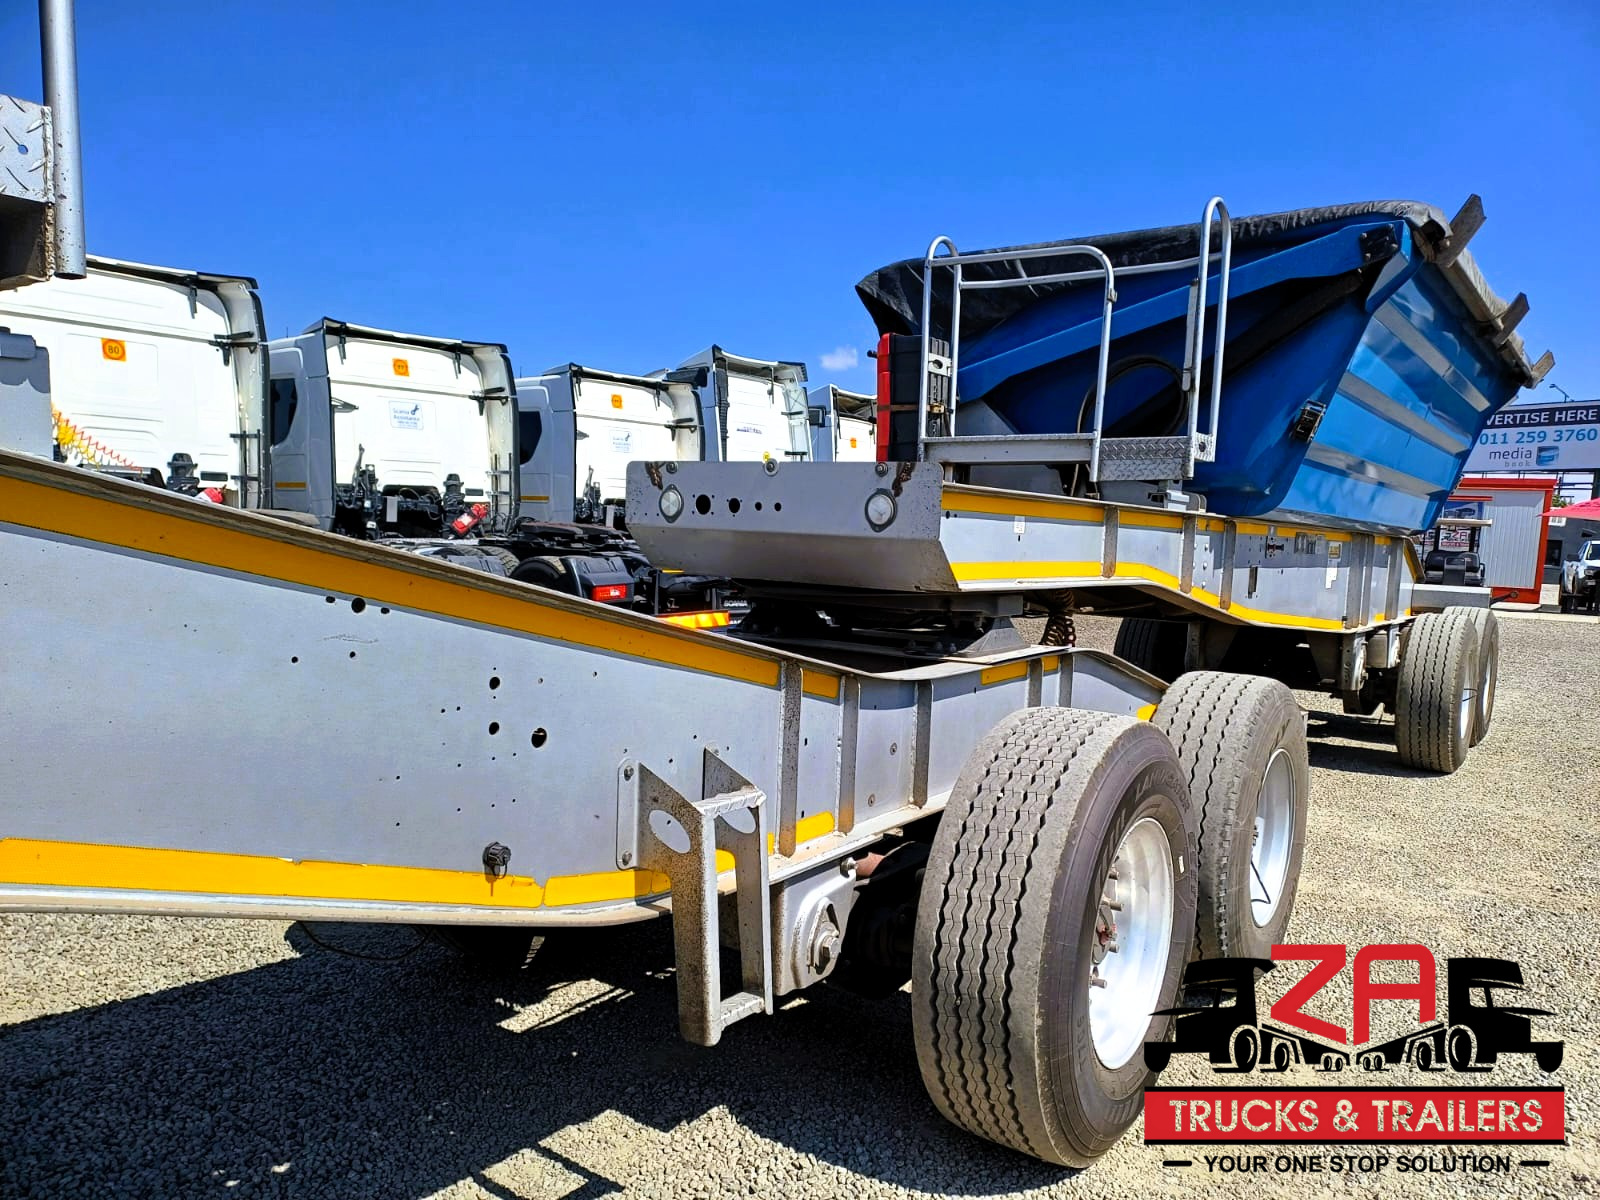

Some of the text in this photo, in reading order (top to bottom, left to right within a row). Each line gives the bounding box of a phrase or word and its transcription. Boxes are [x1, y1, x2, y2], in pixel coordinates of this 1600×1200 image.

[1554, 409, 1598, 422] HERE
[1479, 428, 1598, 445] 011 259 3760
[1488, 447, 1532, 460] media
[1504, 460, 1532, 468] book
